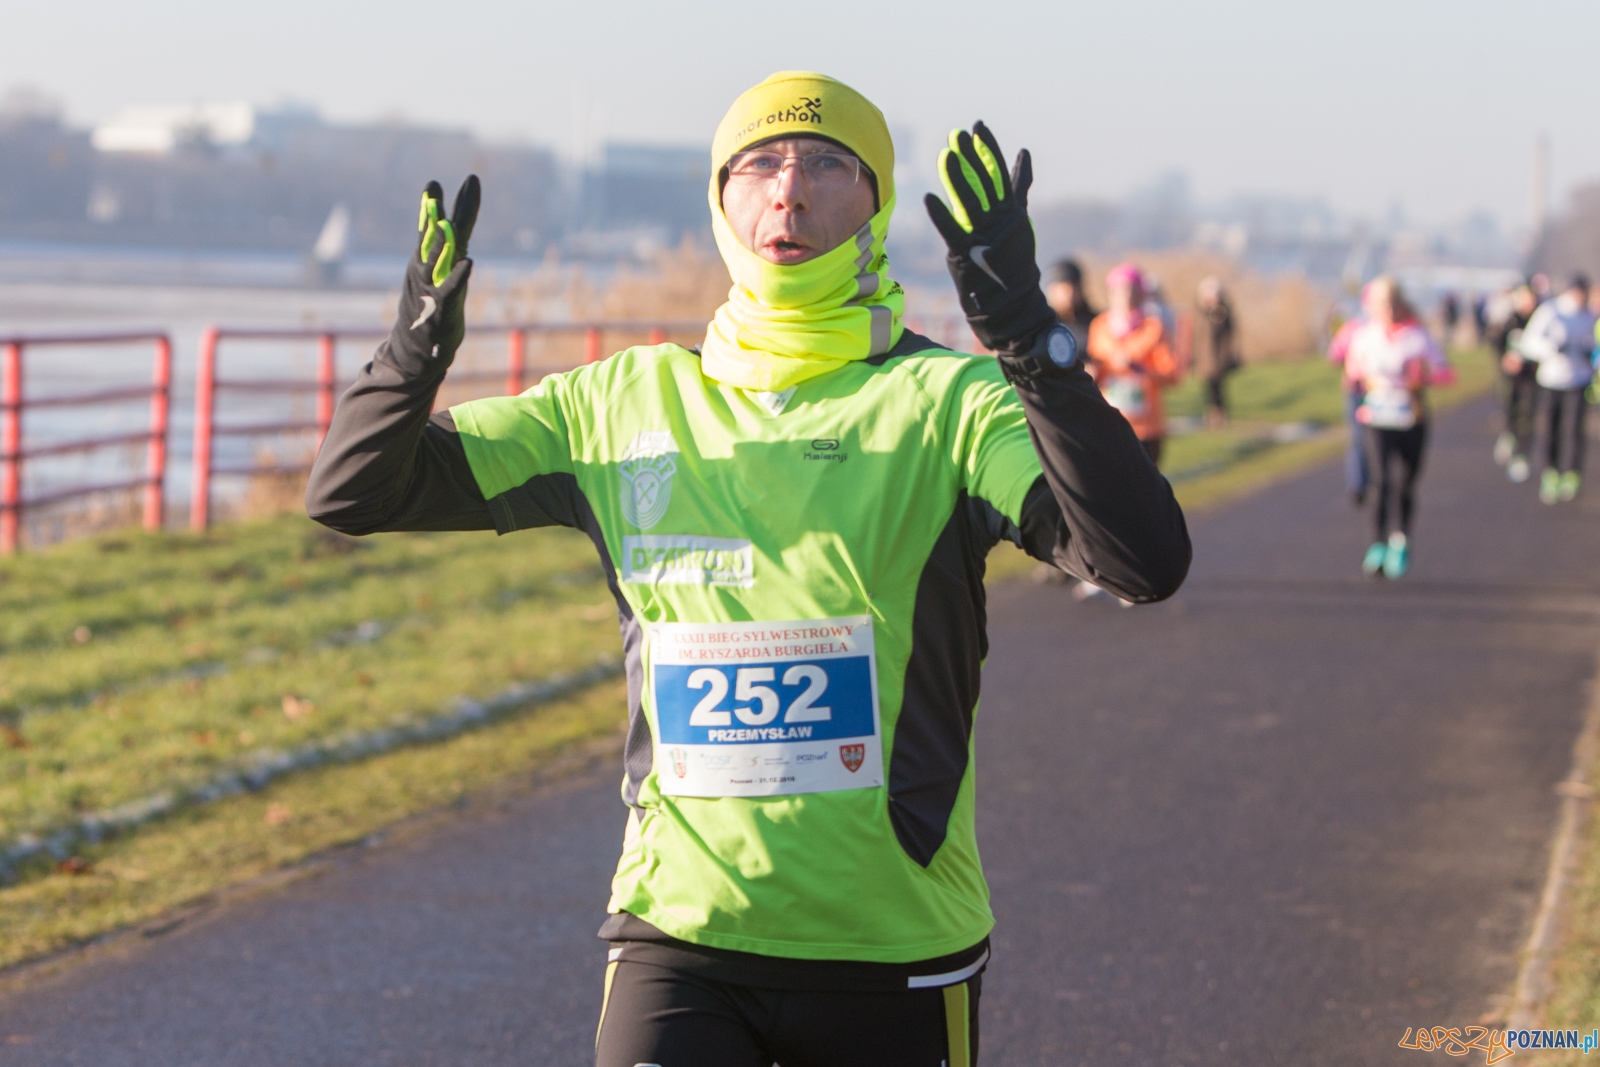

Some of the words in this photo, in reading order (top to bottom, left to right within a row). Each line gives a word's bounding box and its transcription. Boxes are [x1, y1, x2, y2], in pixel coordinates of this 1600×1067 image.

[735, 109, 822, 143] marathon
[803, 451, 848, 463] Kalenji
[708, 631, 741, 643] BIEG
[743, 625, 854, 641] SYLWESTROWY
[699, 646, 771, 660] RYSZARDA
[774, 642, 849, 656] BURGIELA
[686, 664, 832, 727] 252
[708, 726, 813, 742] PRZEMYSŁAW
